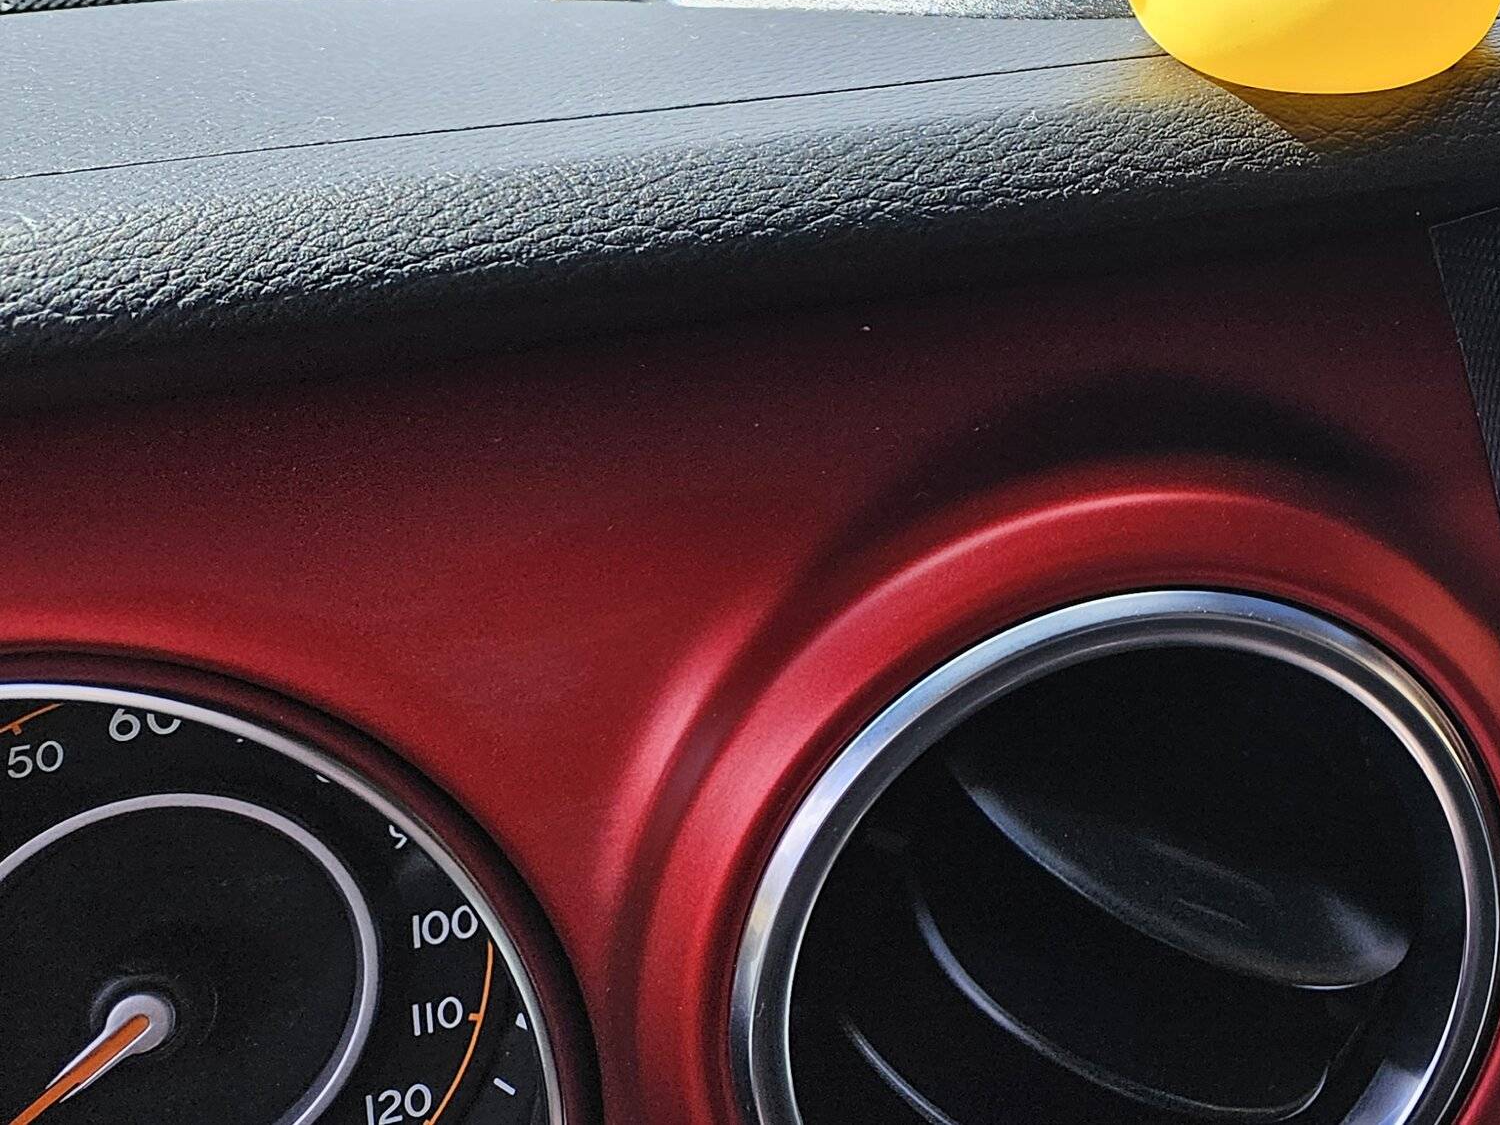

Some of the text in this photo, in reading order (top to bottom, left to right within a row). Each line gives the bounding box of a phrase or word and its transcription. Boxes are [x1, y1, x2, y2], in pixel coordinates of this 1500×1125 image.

[7, 740, 64, 779] 50
[412, 905, 479, 949] 100
[412, 996, 464, 1037] 110
[365, 1083, 432, 1125] 120
